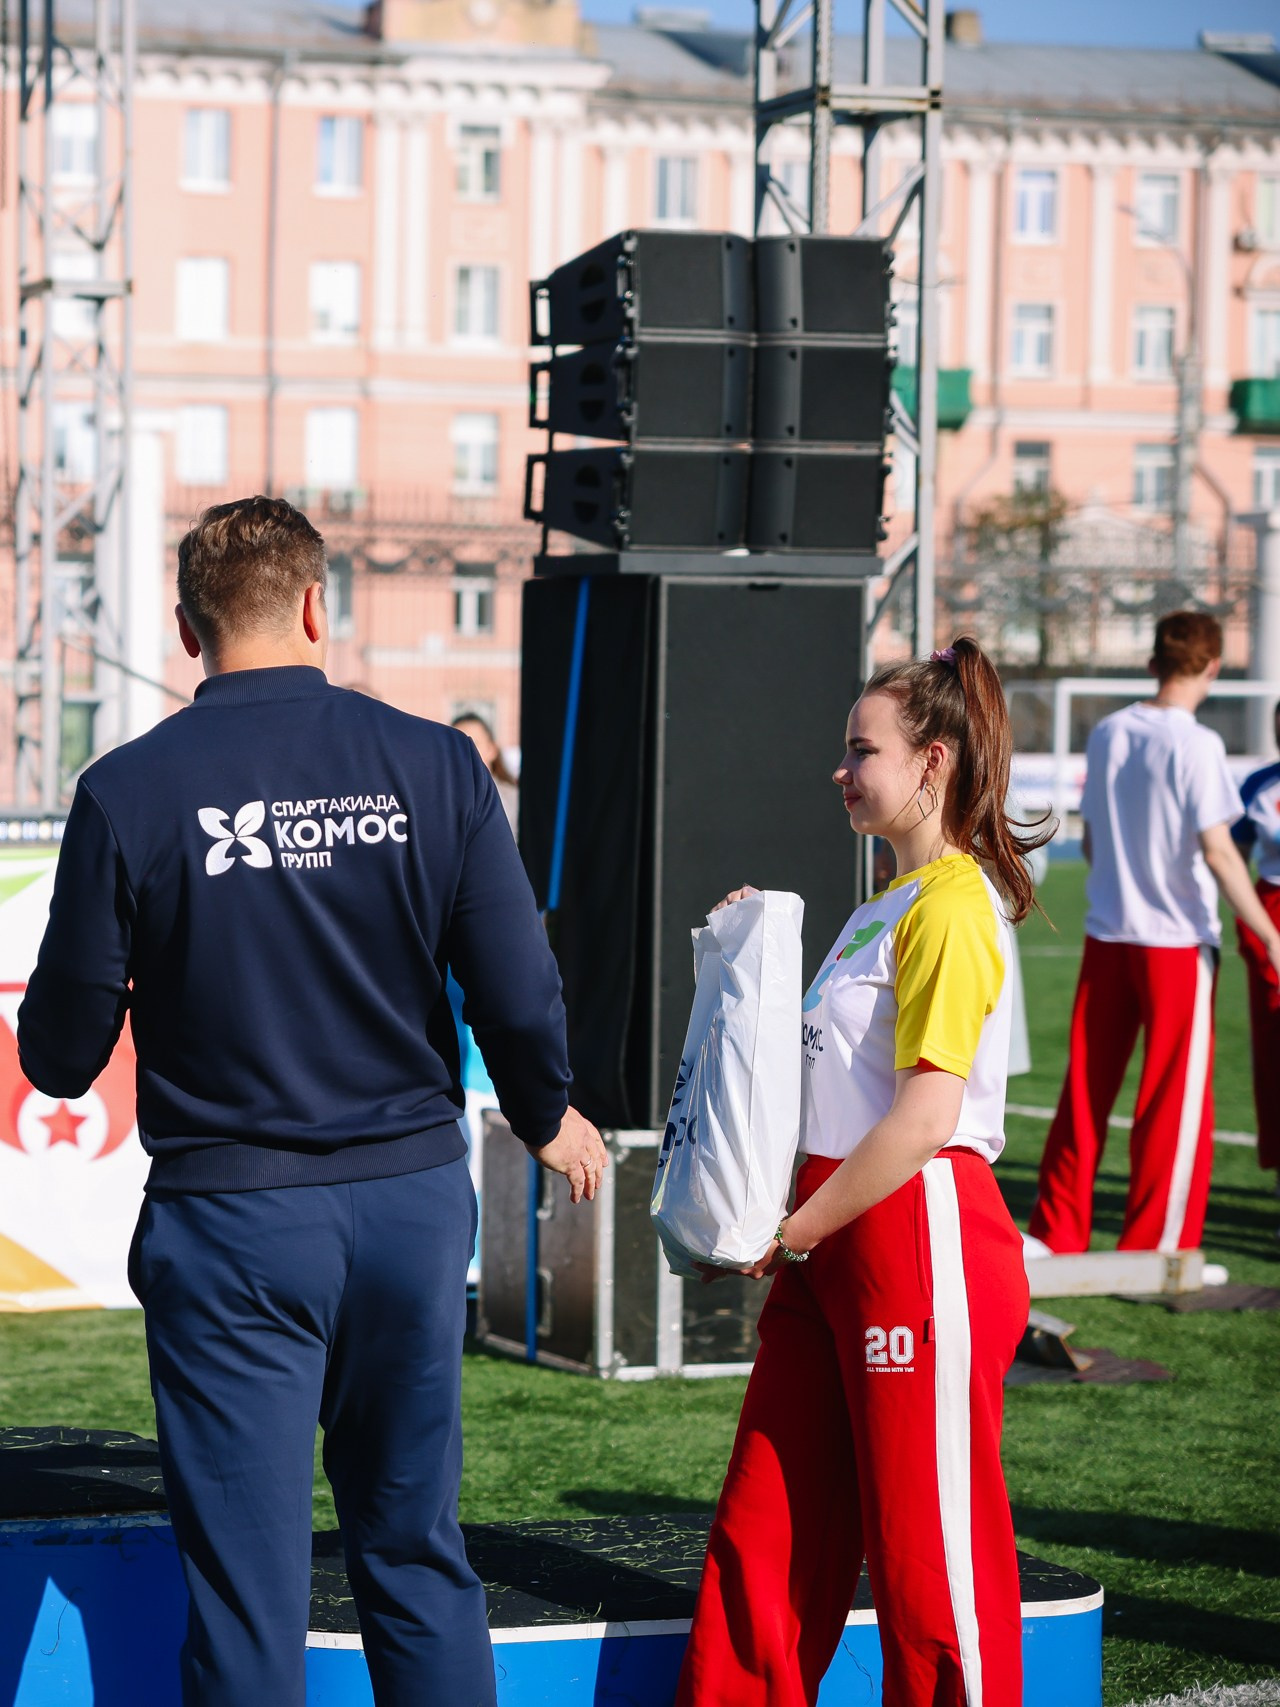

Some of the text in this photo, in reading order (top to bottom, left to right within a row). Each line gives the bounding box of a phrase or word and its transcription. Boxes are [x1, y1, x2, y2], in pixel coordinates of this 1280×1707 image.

[271, 794, 400, 817] СПАРТАКИАДА
[274, 813, 408, 848] КОМОС
[280, 851, 332, 868] ГРУПП
[865, 1325, 915, 1364] 20
